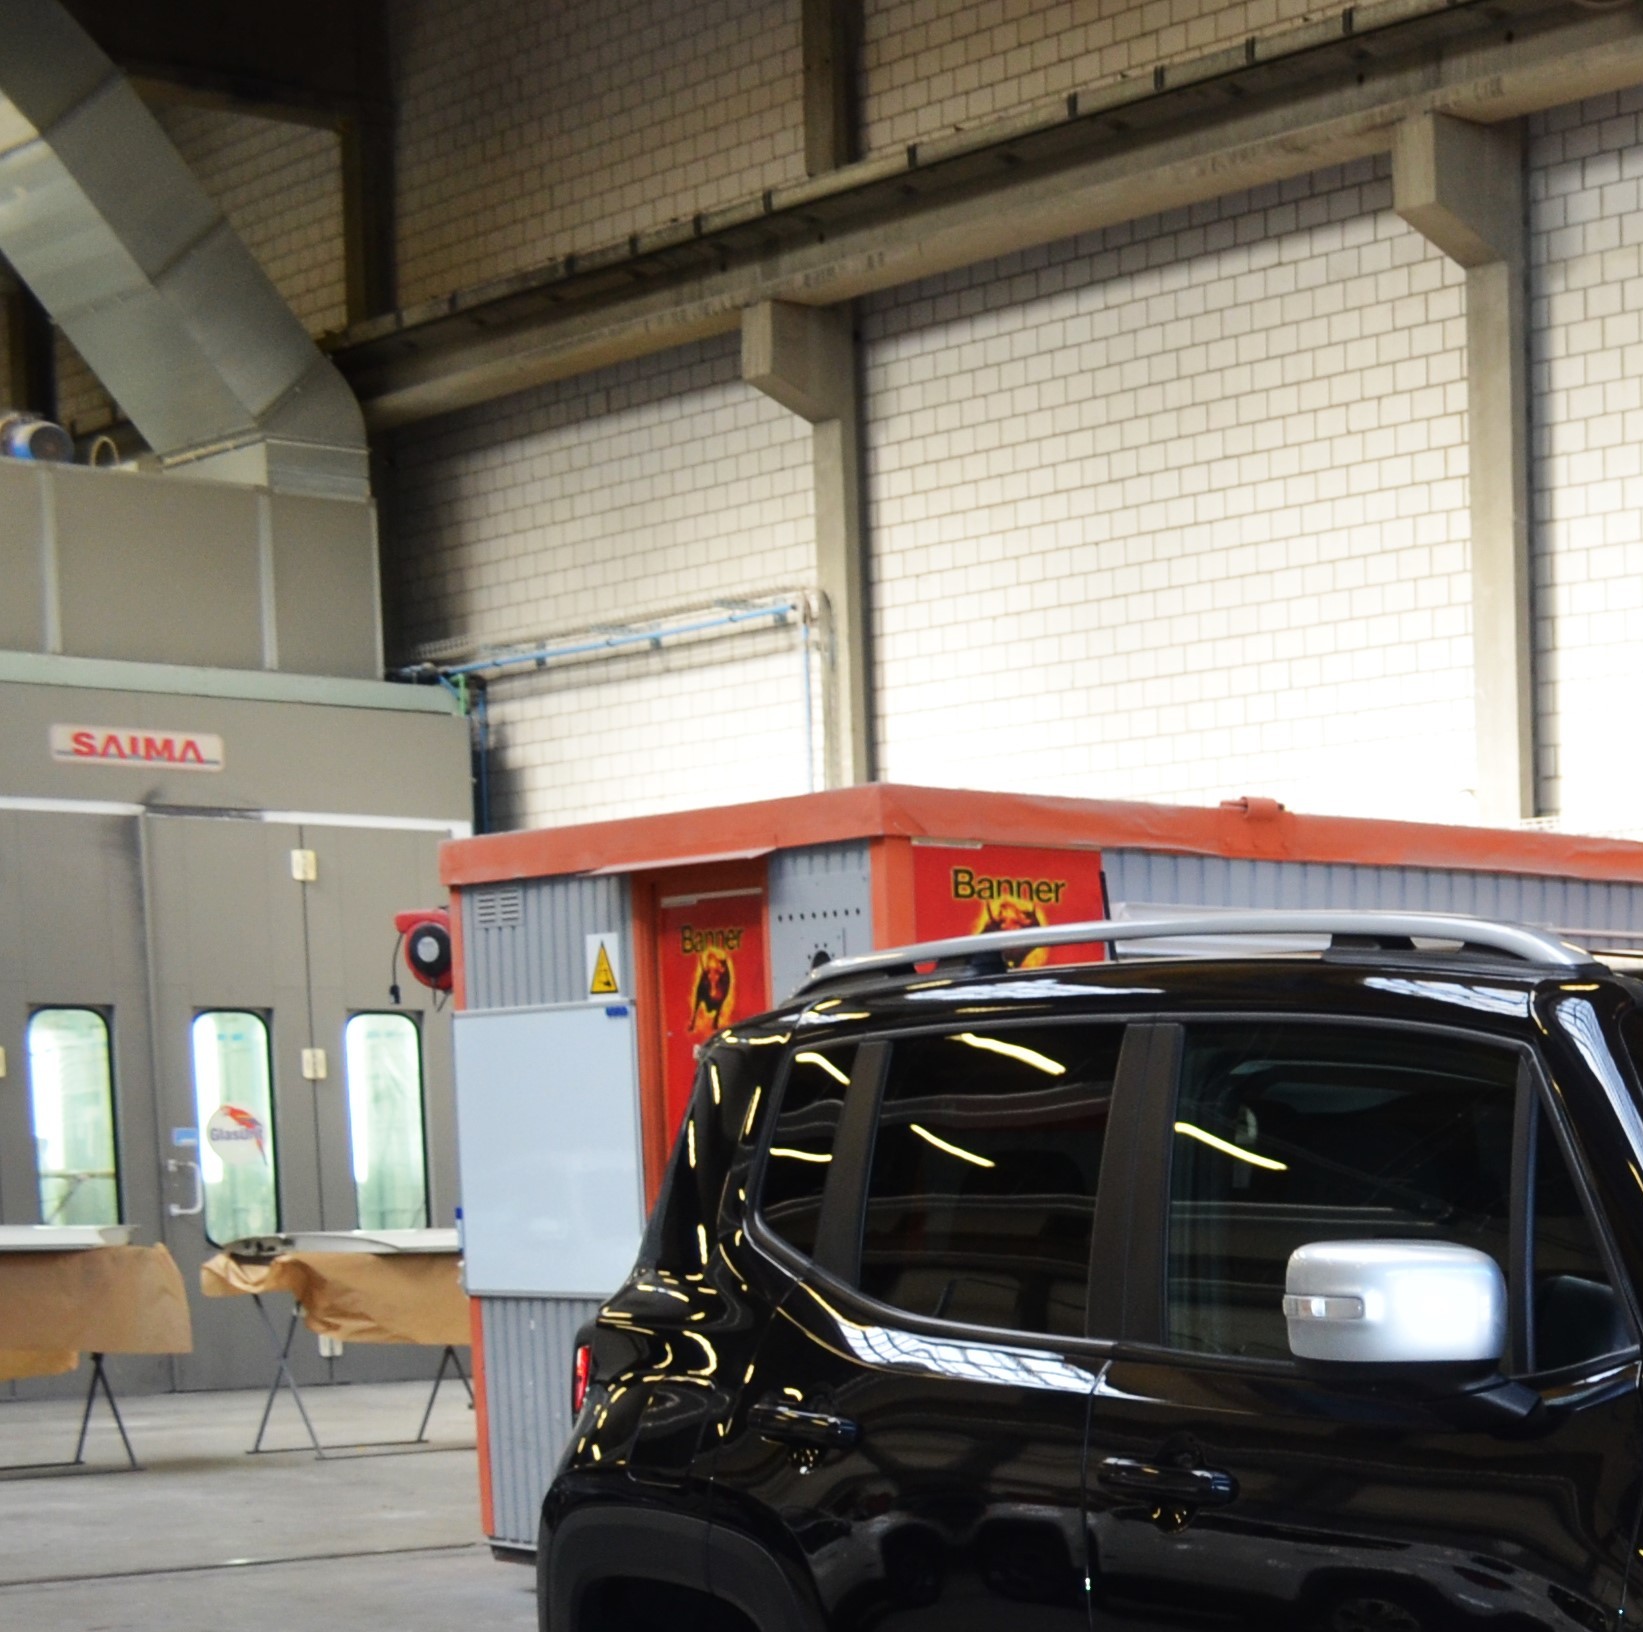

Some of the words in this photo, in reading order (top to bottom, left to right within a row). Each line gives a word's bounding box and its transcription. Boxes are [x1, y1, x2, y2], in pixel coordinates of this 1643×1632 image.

[71, 731, 205, 764] SAIMA
[951, 867, 1067, 904] Banner
[681, 924, 744, 954] Banner
